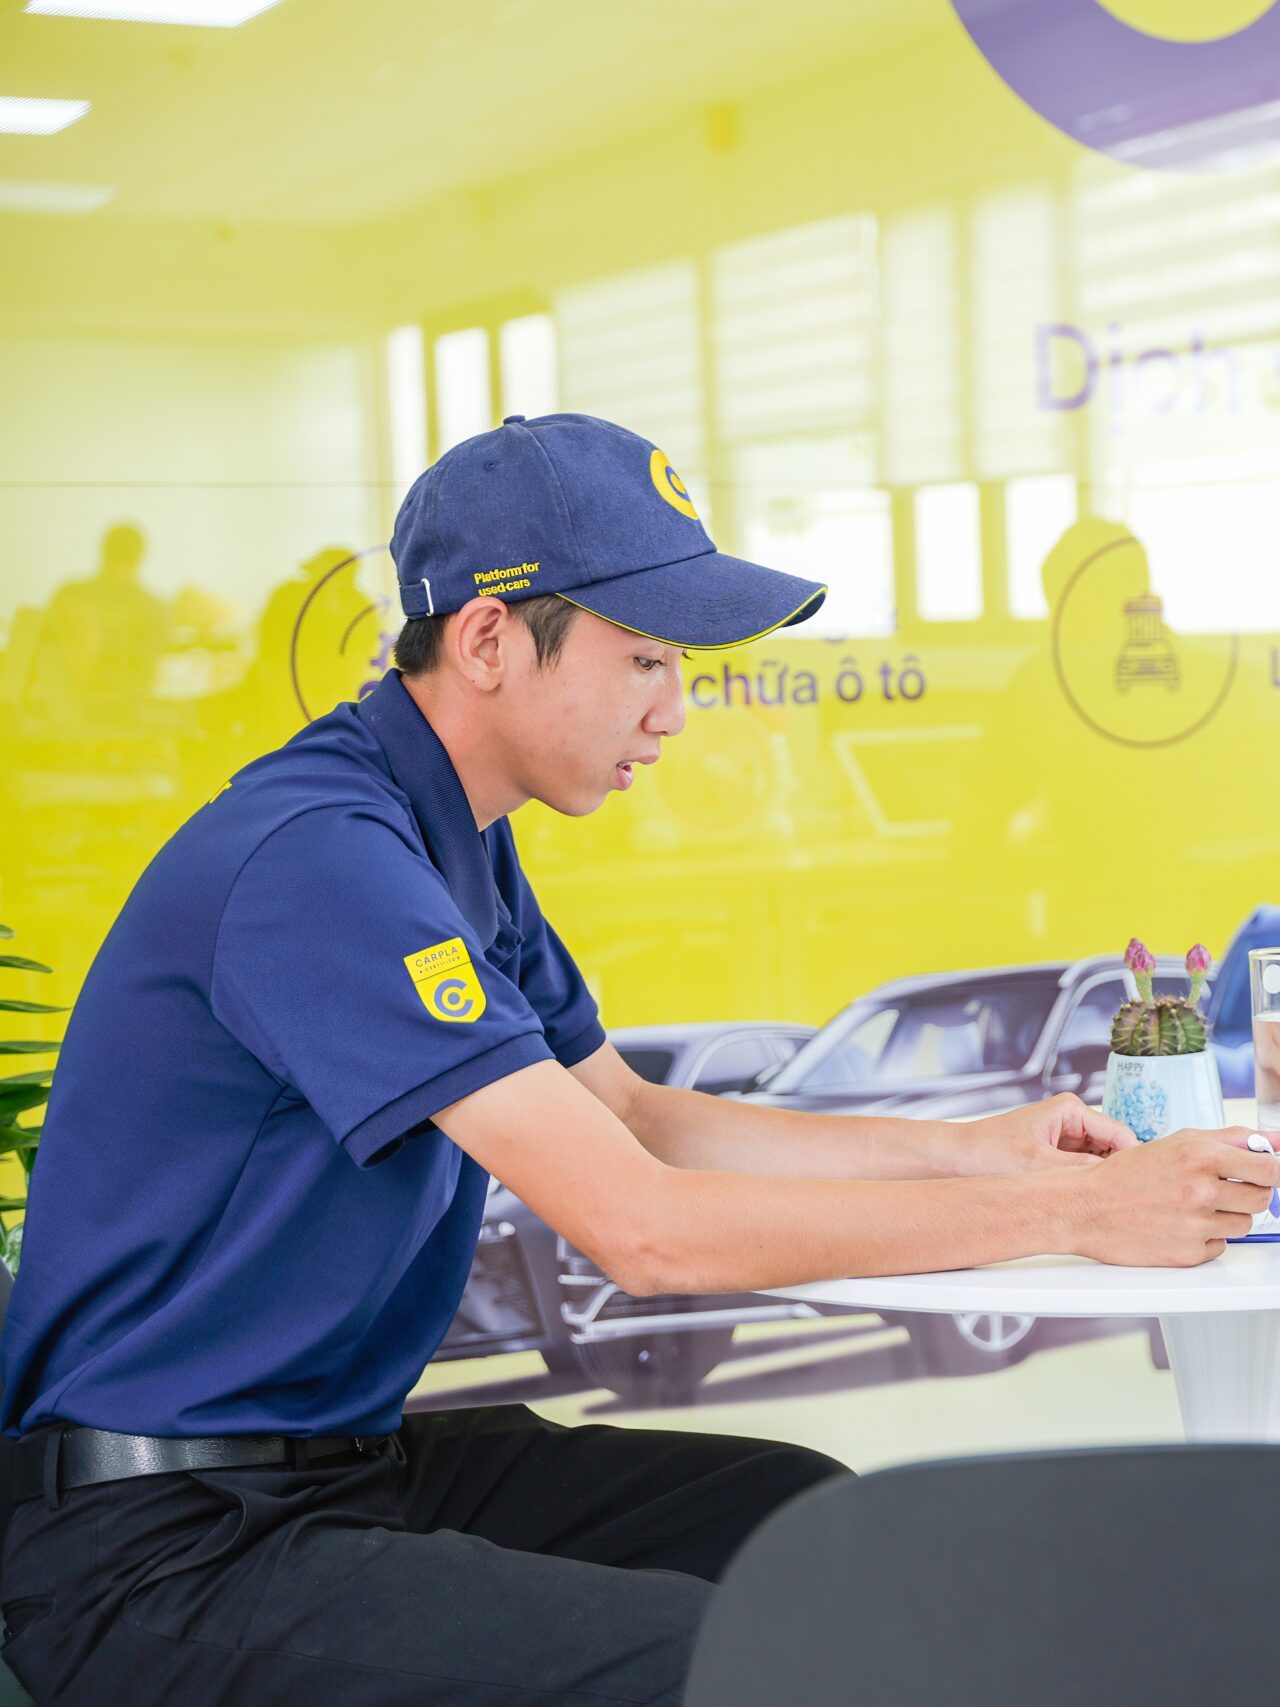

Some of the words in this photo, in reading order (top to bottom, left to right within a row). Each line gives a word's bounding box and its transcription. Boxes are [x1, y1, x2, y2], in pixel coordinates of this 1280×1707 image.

[521, 562, 539, 574] for
[505, 579, 531, 591] cars
[690, 659, 818, 708] chữa
[835, 656, 864, 702] ô
[879, 655, 925, 702] tô
[415, 946, 458, 967] CARPLA
[1117, 1062, 1145, 1072] HAPPY
